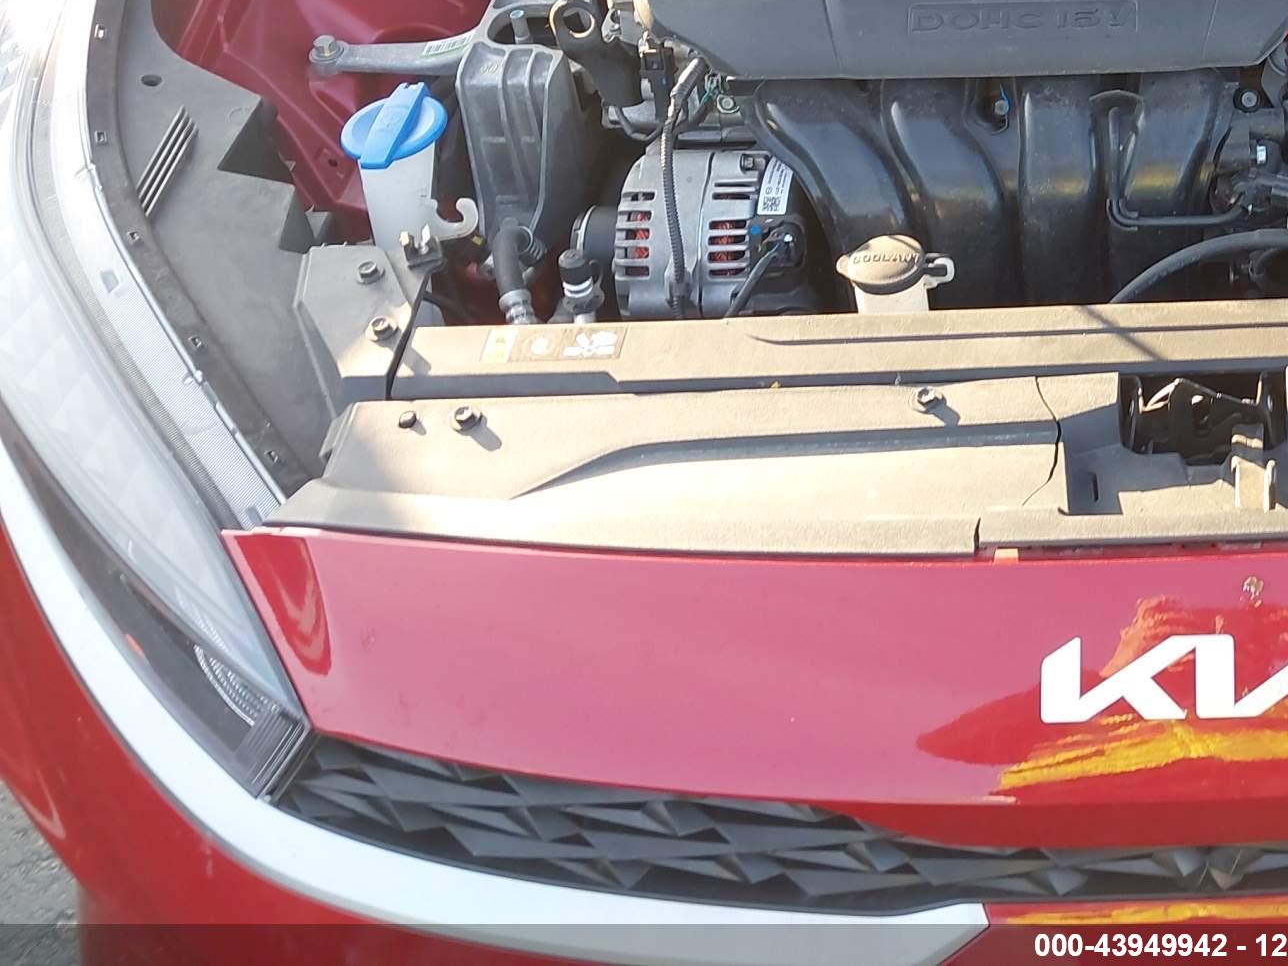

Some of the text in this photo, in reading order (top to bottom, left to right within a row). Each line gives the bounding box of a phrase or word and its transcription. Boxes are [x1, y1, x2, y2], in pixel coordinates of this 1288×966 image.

[911, 7, 1133, 32] DOHC 16V
[851, 251, 921, 265] COOLANT
